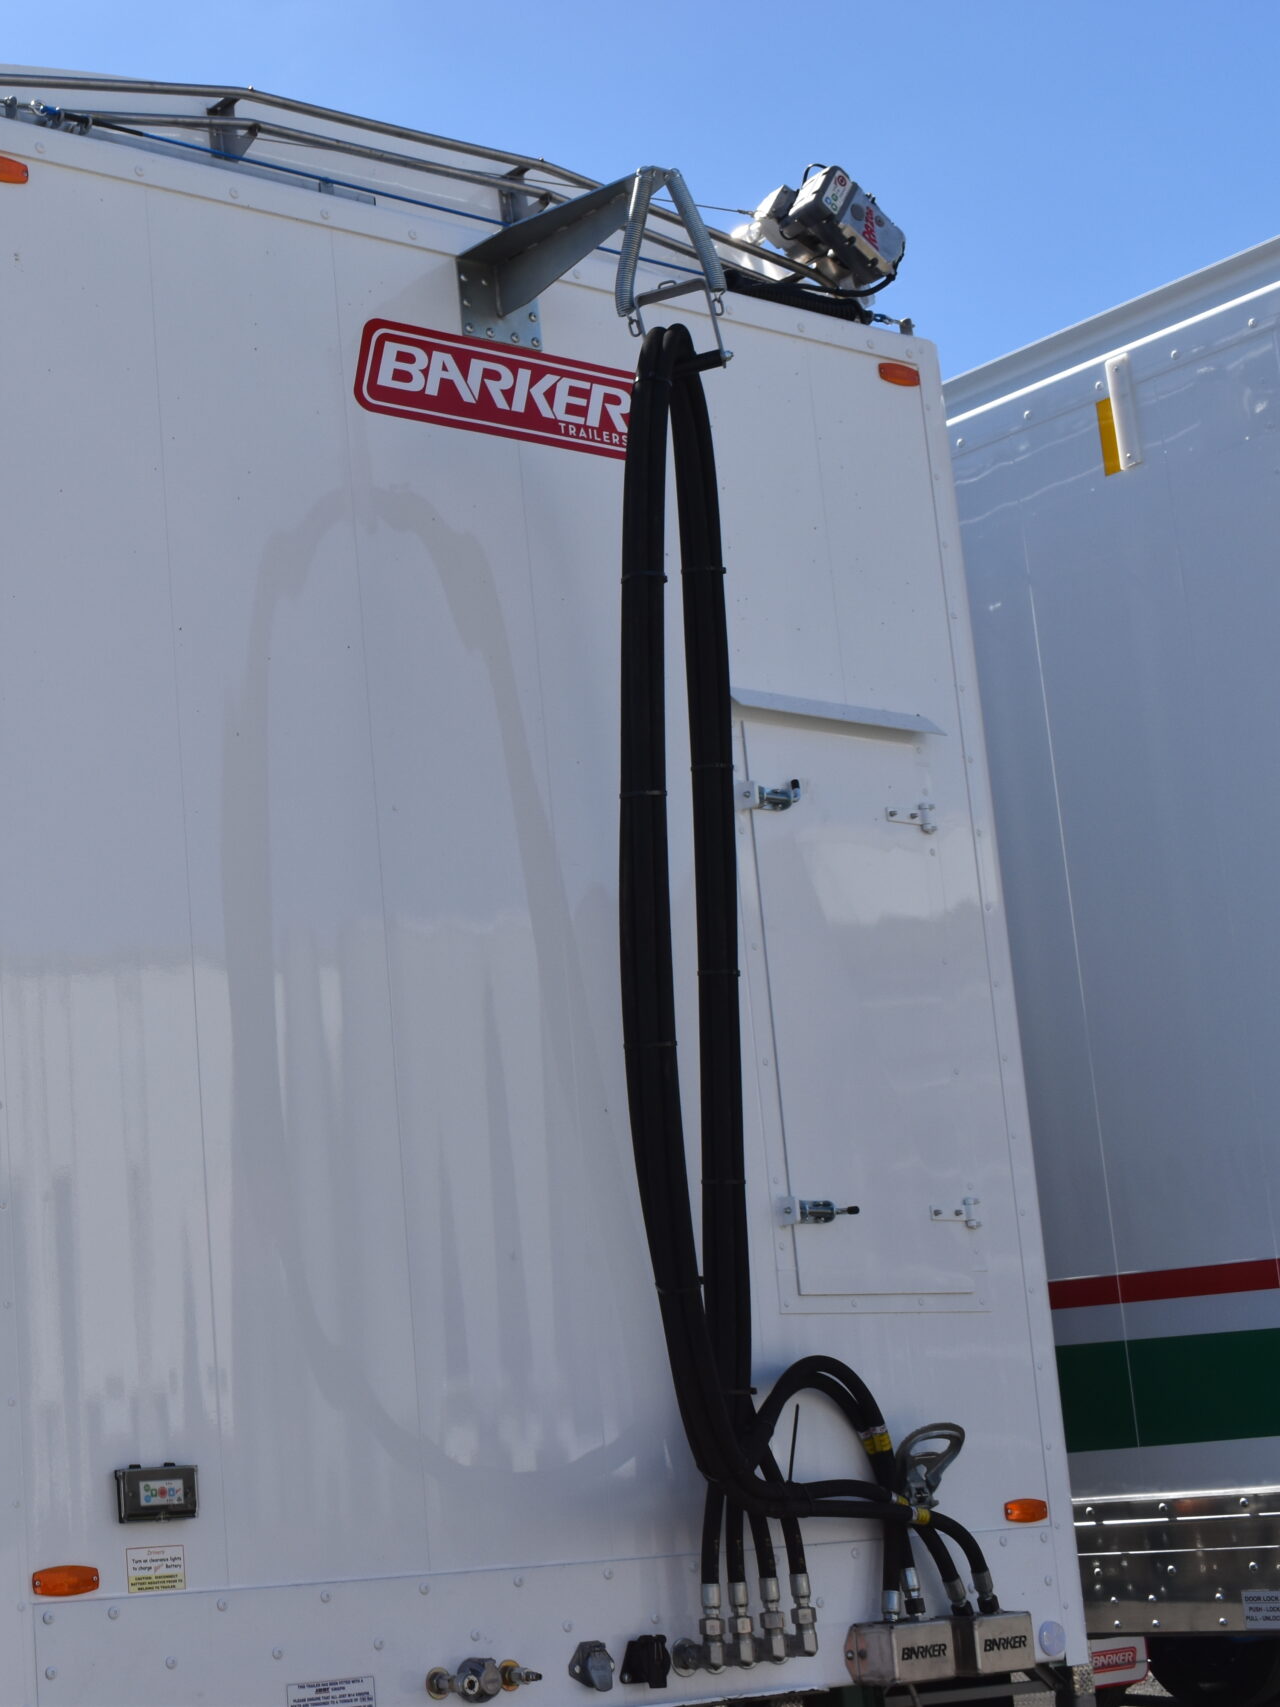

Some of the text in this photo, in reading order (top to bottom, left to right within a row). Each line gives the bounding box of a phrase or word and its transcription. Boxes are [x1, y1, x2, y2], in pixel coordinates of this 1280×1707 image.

[376, 341, 631, 434] BARKER
[558, 422, 628, 446] TRAILERS
[901, 1643, 947, 1661] BARKER
[984, 1635, 1027, 1652] BARKER
[1093, 1651, 1134, 1666] BARKER
